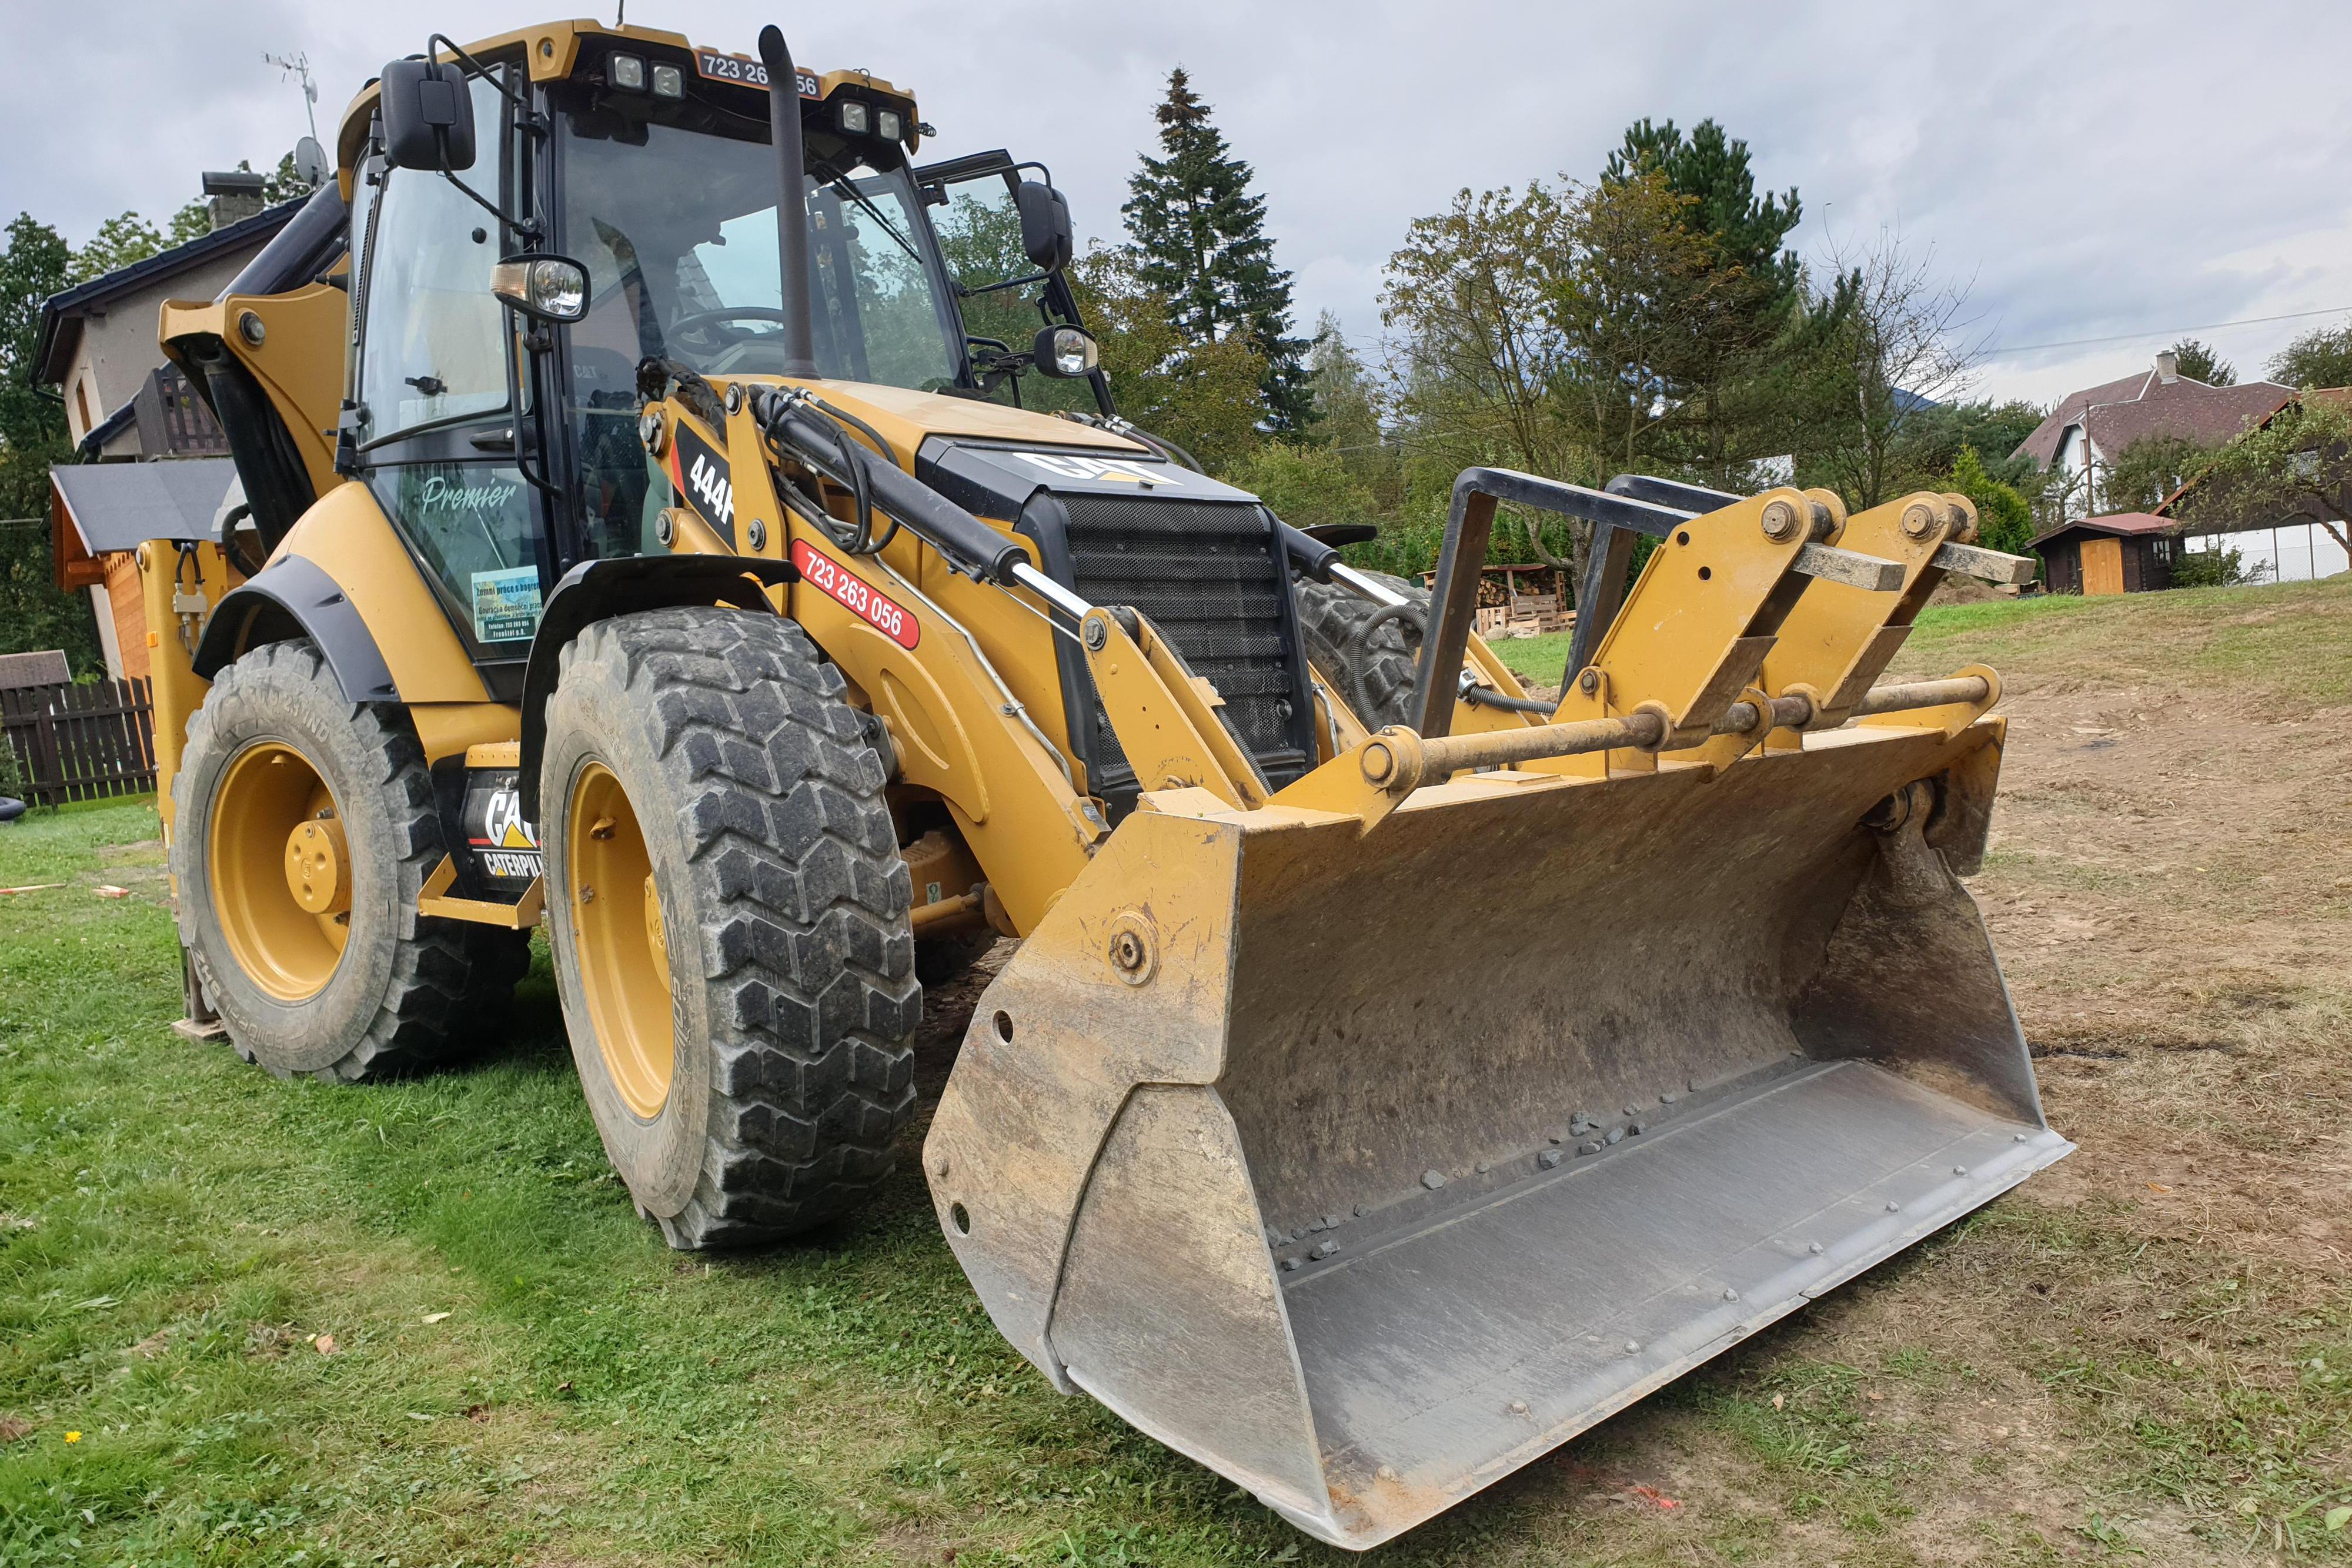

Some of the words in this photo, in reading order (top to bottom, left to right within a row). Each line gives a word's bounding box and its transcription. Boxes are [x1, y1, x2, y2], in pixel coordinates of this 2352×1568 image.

[704, 55, 740, 79] 723
[745, 63, 769, 85] 26
[796, 76, 817, 95] 56
[573, 364, 599, 379] CAT
[1012, 452, 1185, 486] CAT
[422, 476, 517, 515] Premier
[806, 551, 835, 589] 723
[837, 574, 868, 612] 263
[871, 597, 903, 636] 056
